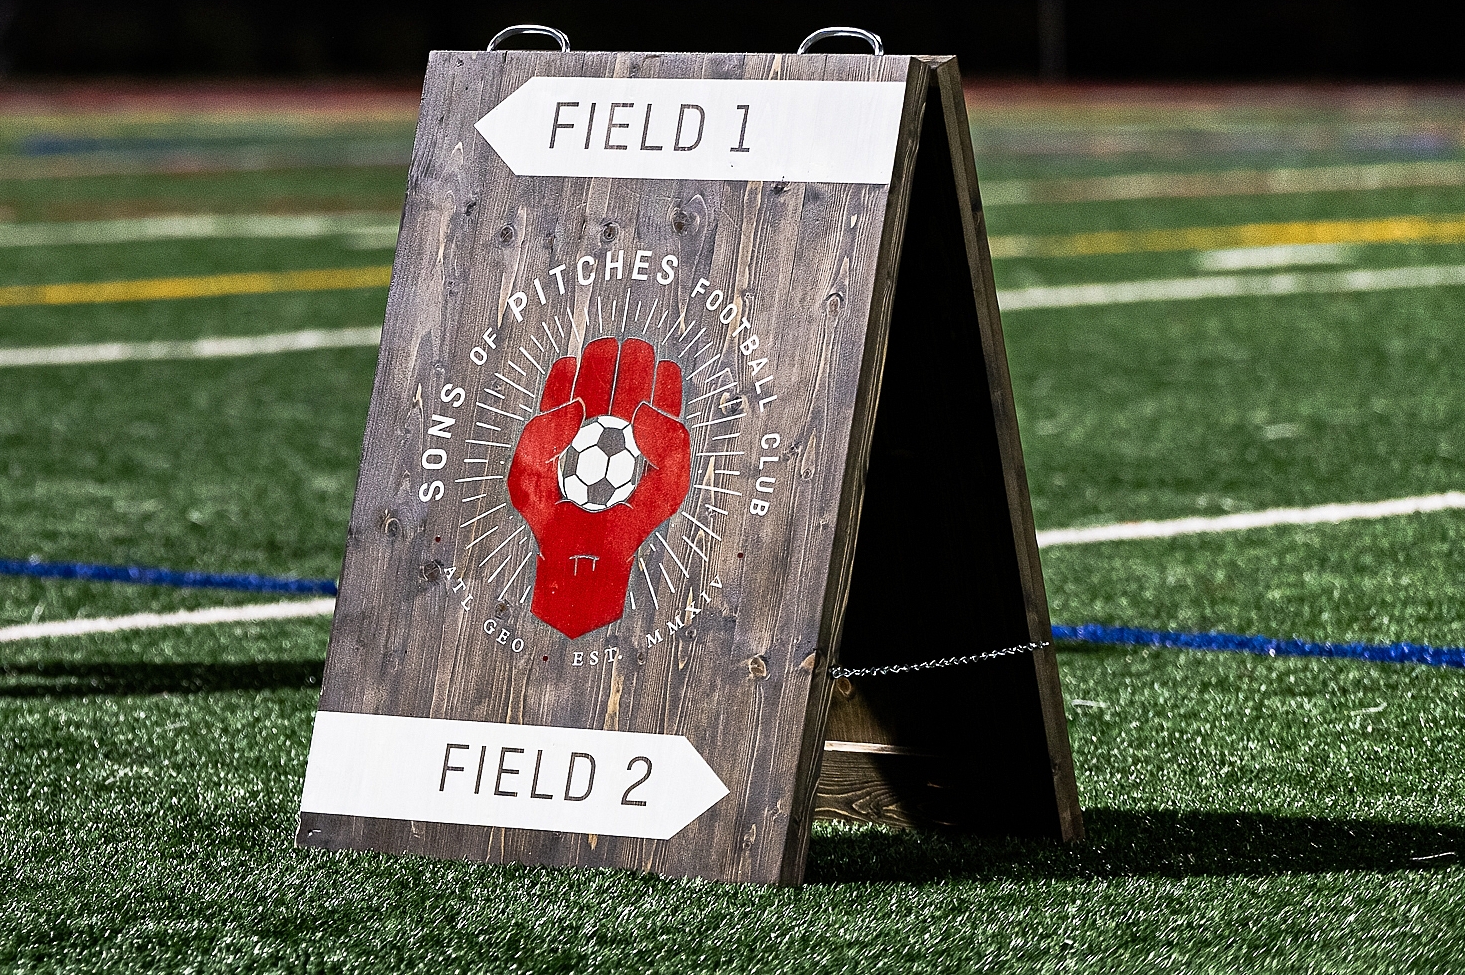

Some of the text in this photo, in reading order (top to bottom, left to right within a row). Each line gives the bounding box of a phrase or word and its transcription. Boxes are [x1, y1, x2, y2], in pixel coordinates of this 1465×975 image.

[548, 101, 751, 153] FIELD 1
[418, 249, 781, 517] SONS OF PITCHES FOOTBALL CLUB
[443, 565, 525, 653] ATL GEO
[571, 575, 723, 667] EST. MMXIV
[438, 742, 654, 807] FIELD 2
